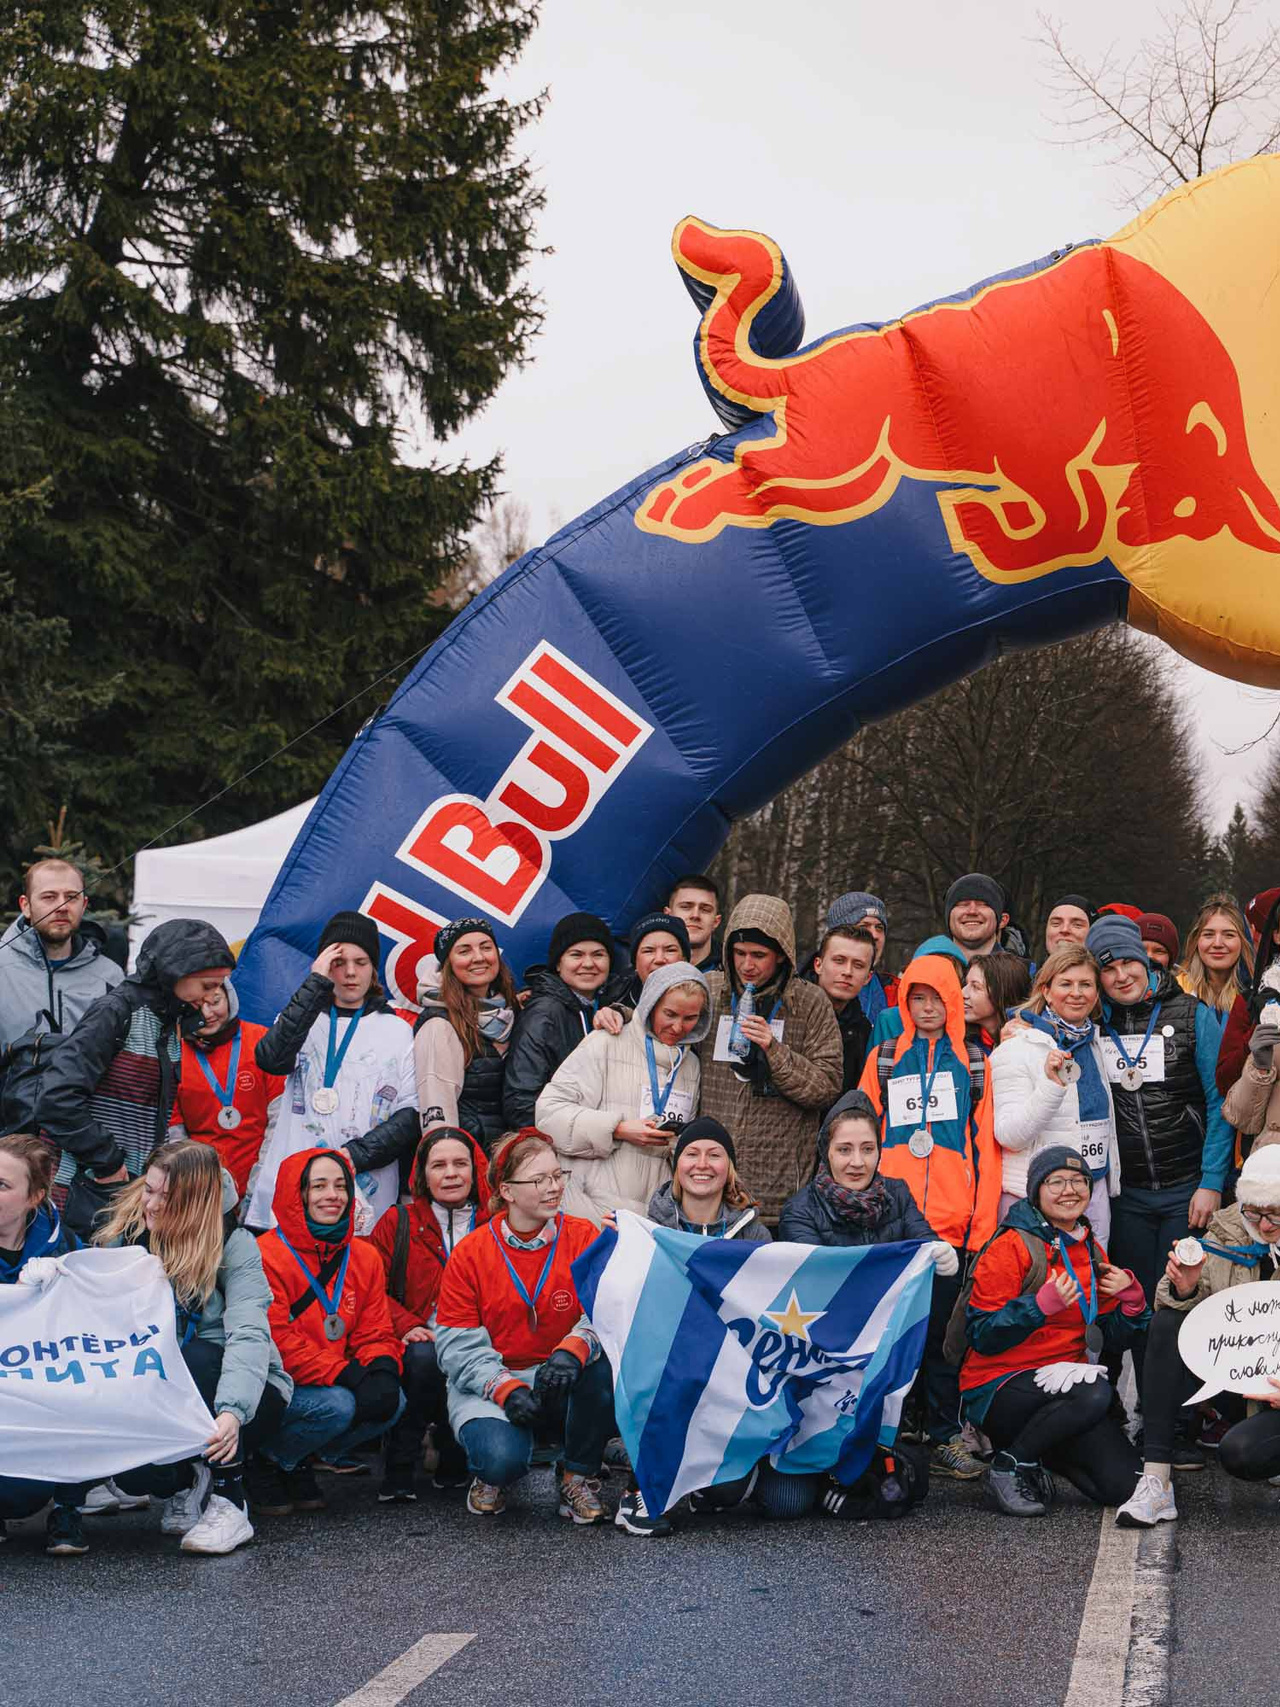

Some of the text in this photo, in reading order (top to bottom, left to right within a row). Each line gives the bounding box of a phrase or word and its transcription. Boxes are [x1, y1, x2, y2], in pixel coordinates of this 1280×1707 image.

[395, 639, 655, 928] Bull
[1116, 1056, 1148, 1070] 65
[1081, 1142, 1104, 1158] 666
